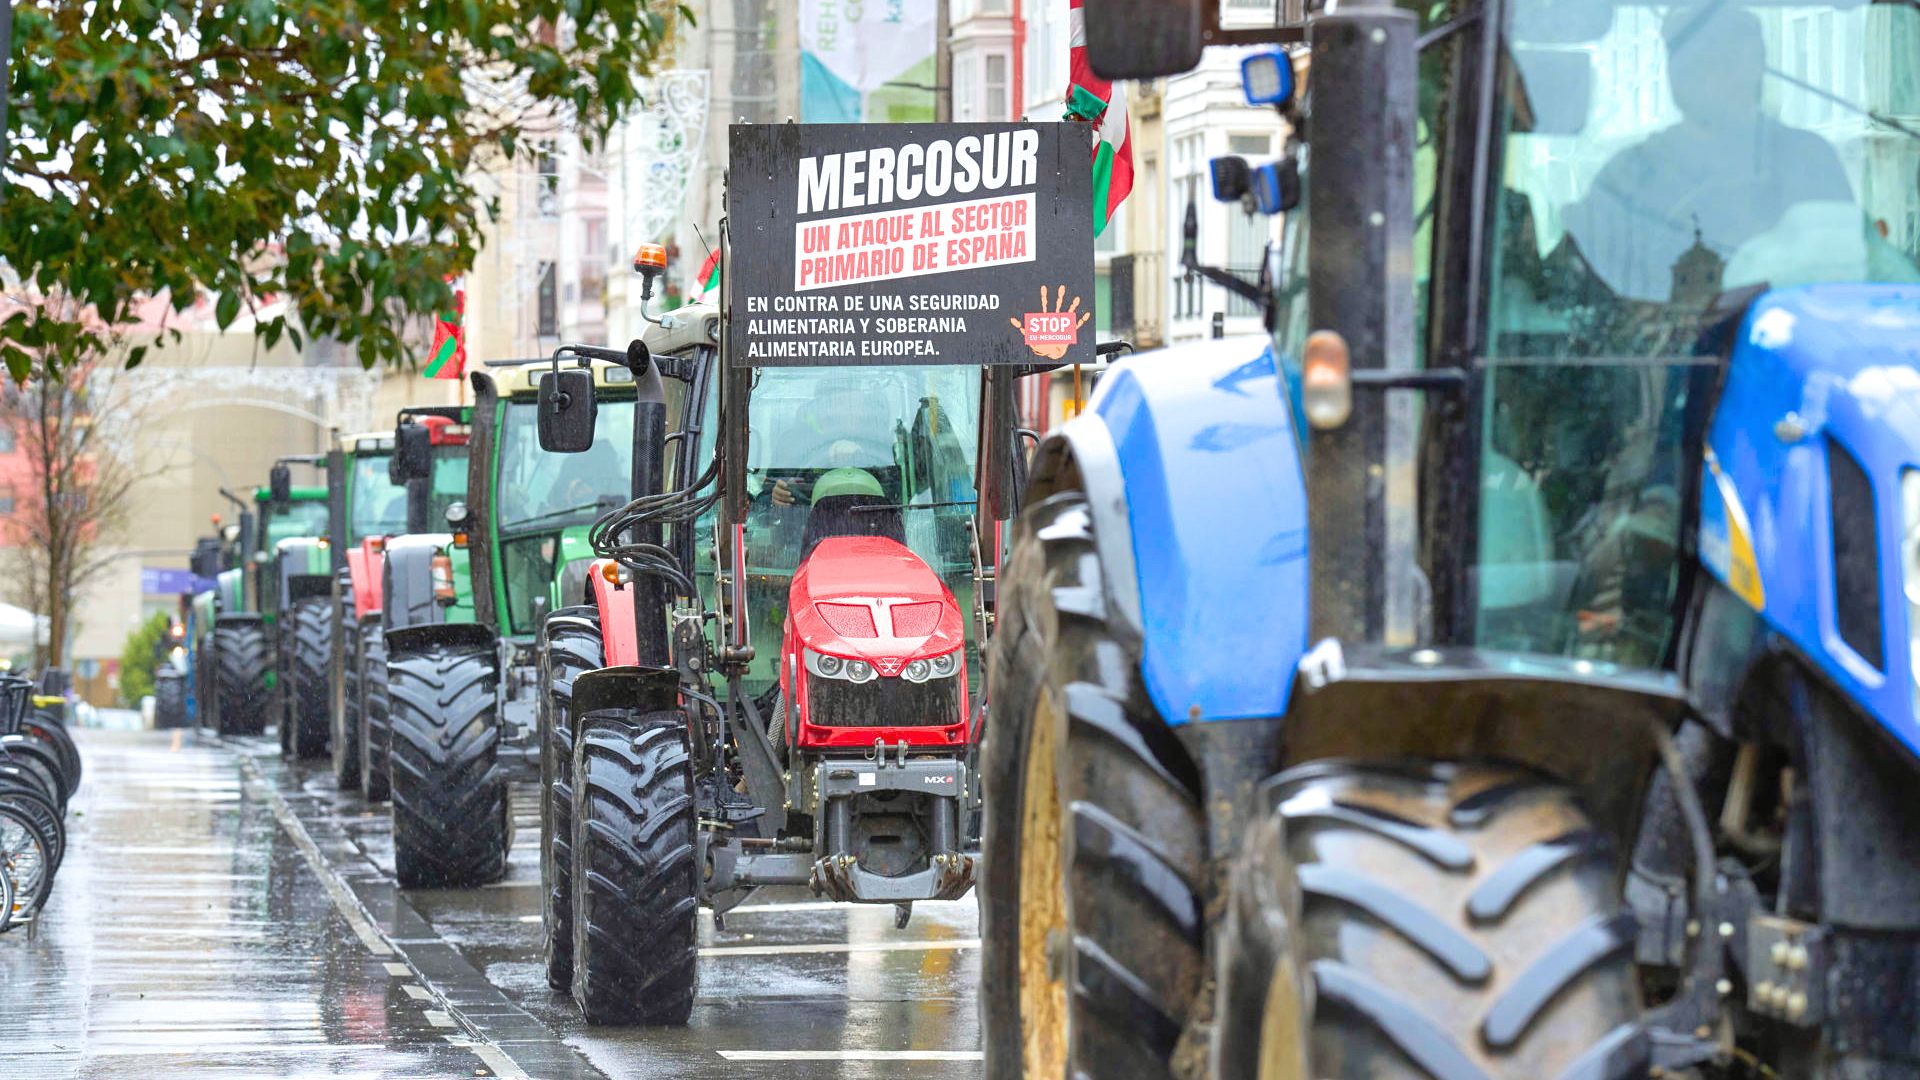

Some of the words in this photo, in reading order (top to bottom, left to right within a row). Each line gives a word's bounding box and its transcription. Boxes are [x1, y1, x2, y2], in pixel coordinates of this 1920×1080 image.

[797, 129, 1038, 215] MERCOSUR
[804, 226, 830, 253] UN
[838, 215, 913, 250] ATAQUE
[920, 211, 944, 238] AL
[952, 200, 1027, 235] SECTOR
[801, 247, 904, 286] PRIMARIO
[913, 243, 938, 271] DE
[947, 226, 1026, 266] ESPAÑA
[748, 297, 768, 312] EN
[775, 296, 838, 311] CONTRA
[844, 296, 864, 311] DE
[870, 296, 904, 310] UNA
[910, 295, 999, 310] SEGURIDAD
[748, 319, 855, 334] ALIMENTARIA
[860, 318, 870, 333] Y
[876, 317, 966, 333] SOBERANIA
[1030, 317, 1070, 332] STOP
[748, 341, 855, 357] ALIMENTARIA
[862, 340, 939, 357] EUROPEA.
